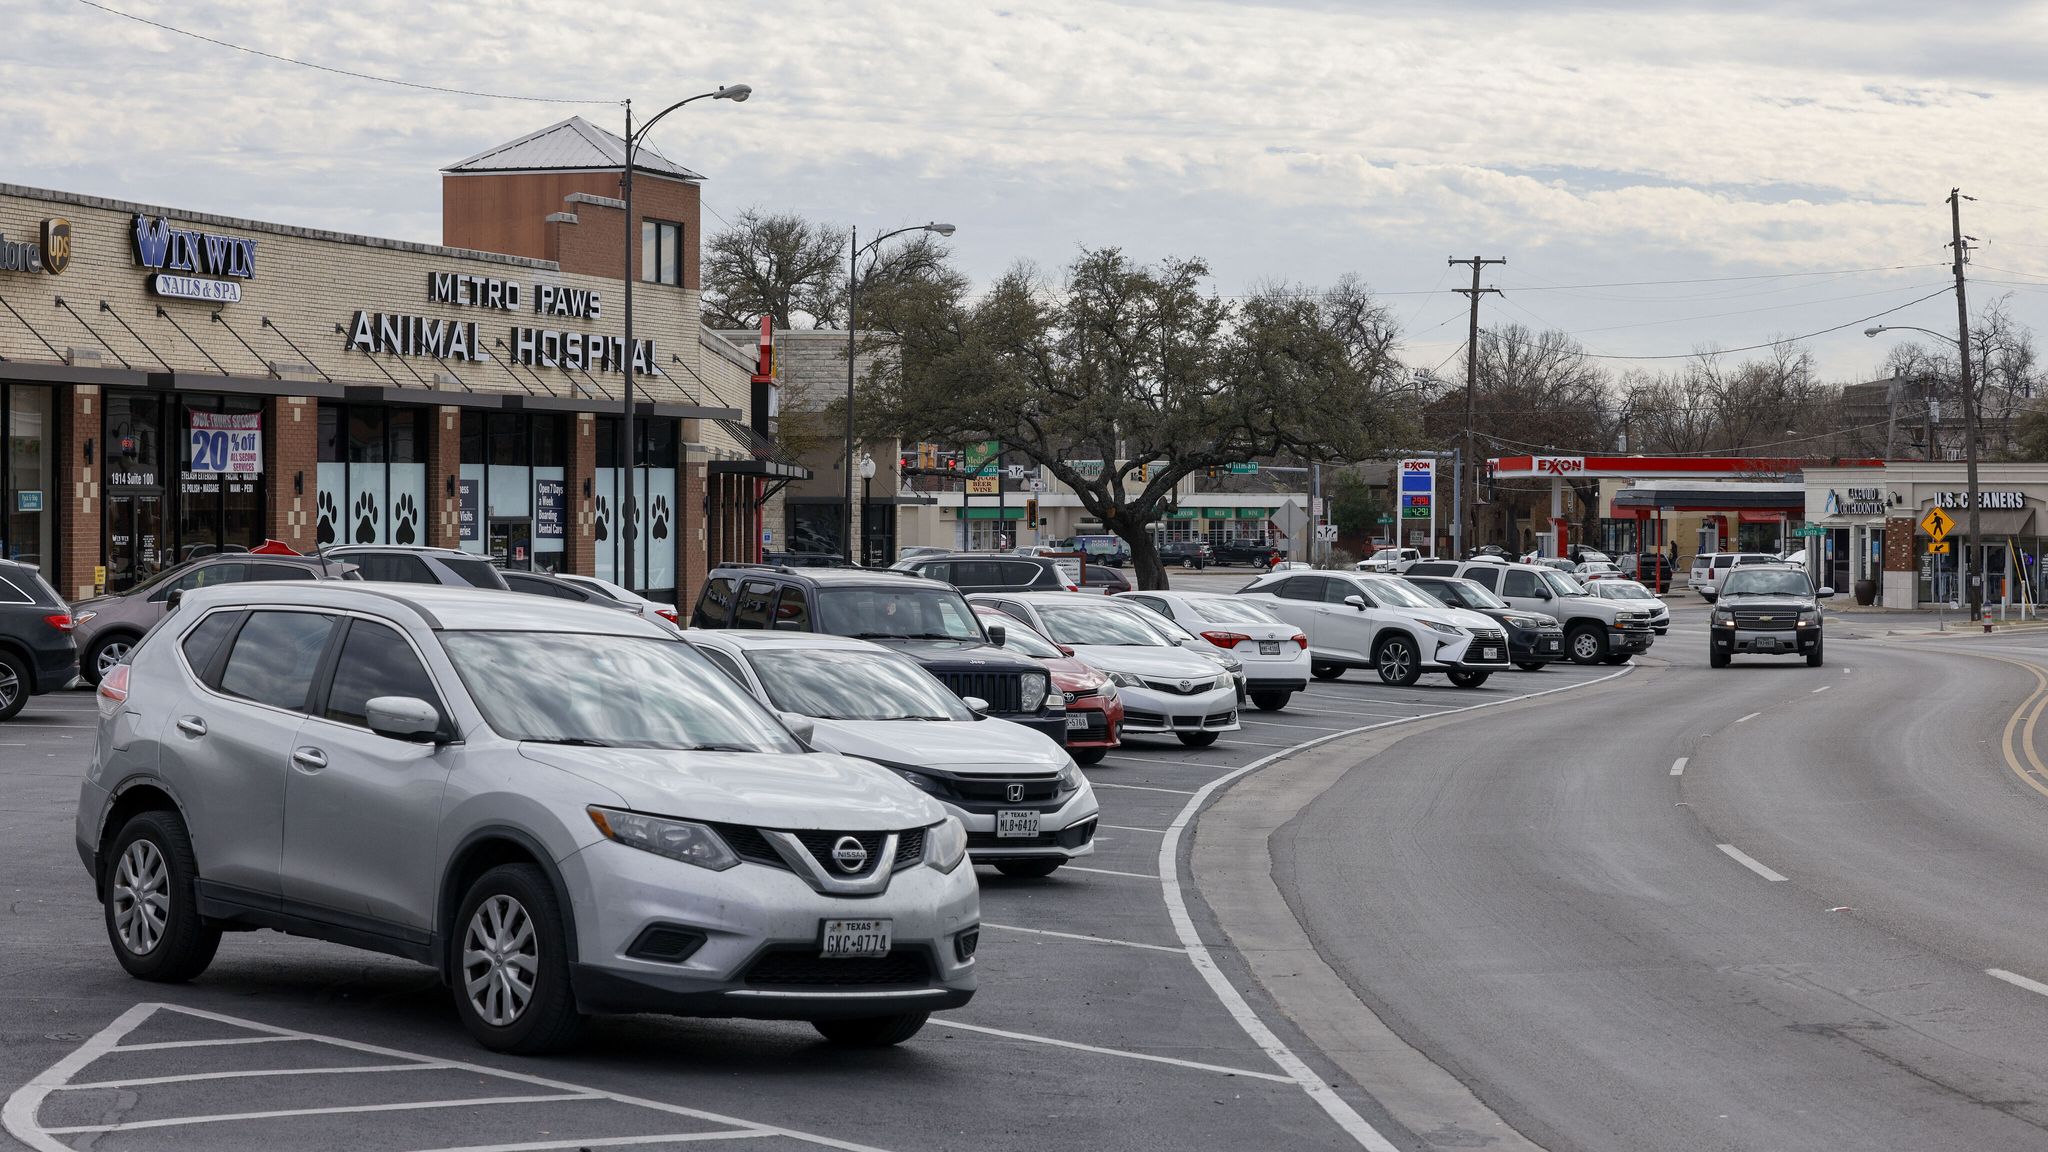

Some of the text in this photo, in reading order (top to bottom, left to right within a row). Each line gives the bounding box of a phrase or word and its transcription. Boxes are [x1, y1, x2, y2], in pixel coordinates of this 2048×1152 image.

[0, 233, 40, 273] tore
[50, 235, 69, 265] ups
[137, 213, 257, 280] WIN WIN
[162, 276, 238, 300] NAILS & SPA
[431, 271, 601, 319] METRO PAWS
[348, 310, 662, 376] ANIMAL HOSPITAL
[192, 430, 229, 471] 20
[241, 433, 256, 451] off
[231, 453, 239, 461] ALL
[1404, 461, 1430, 471] EXXON
[1538, 458, 1582, 475] EXXON
[112, 472, 154, 485] 1914 Suite 100
[539, 483, 550, 495] Open
[553, 484, 564, 496] Days
[1934, 492, 2023, 508] U.S. CEANERS
[1840, 502, 1883, 515] ORTHODONTICS
[460, 526, 471, 536] eries
[539, 523, 562, 534] Dental Care
[846, 923, 872, 931] TEXAS
